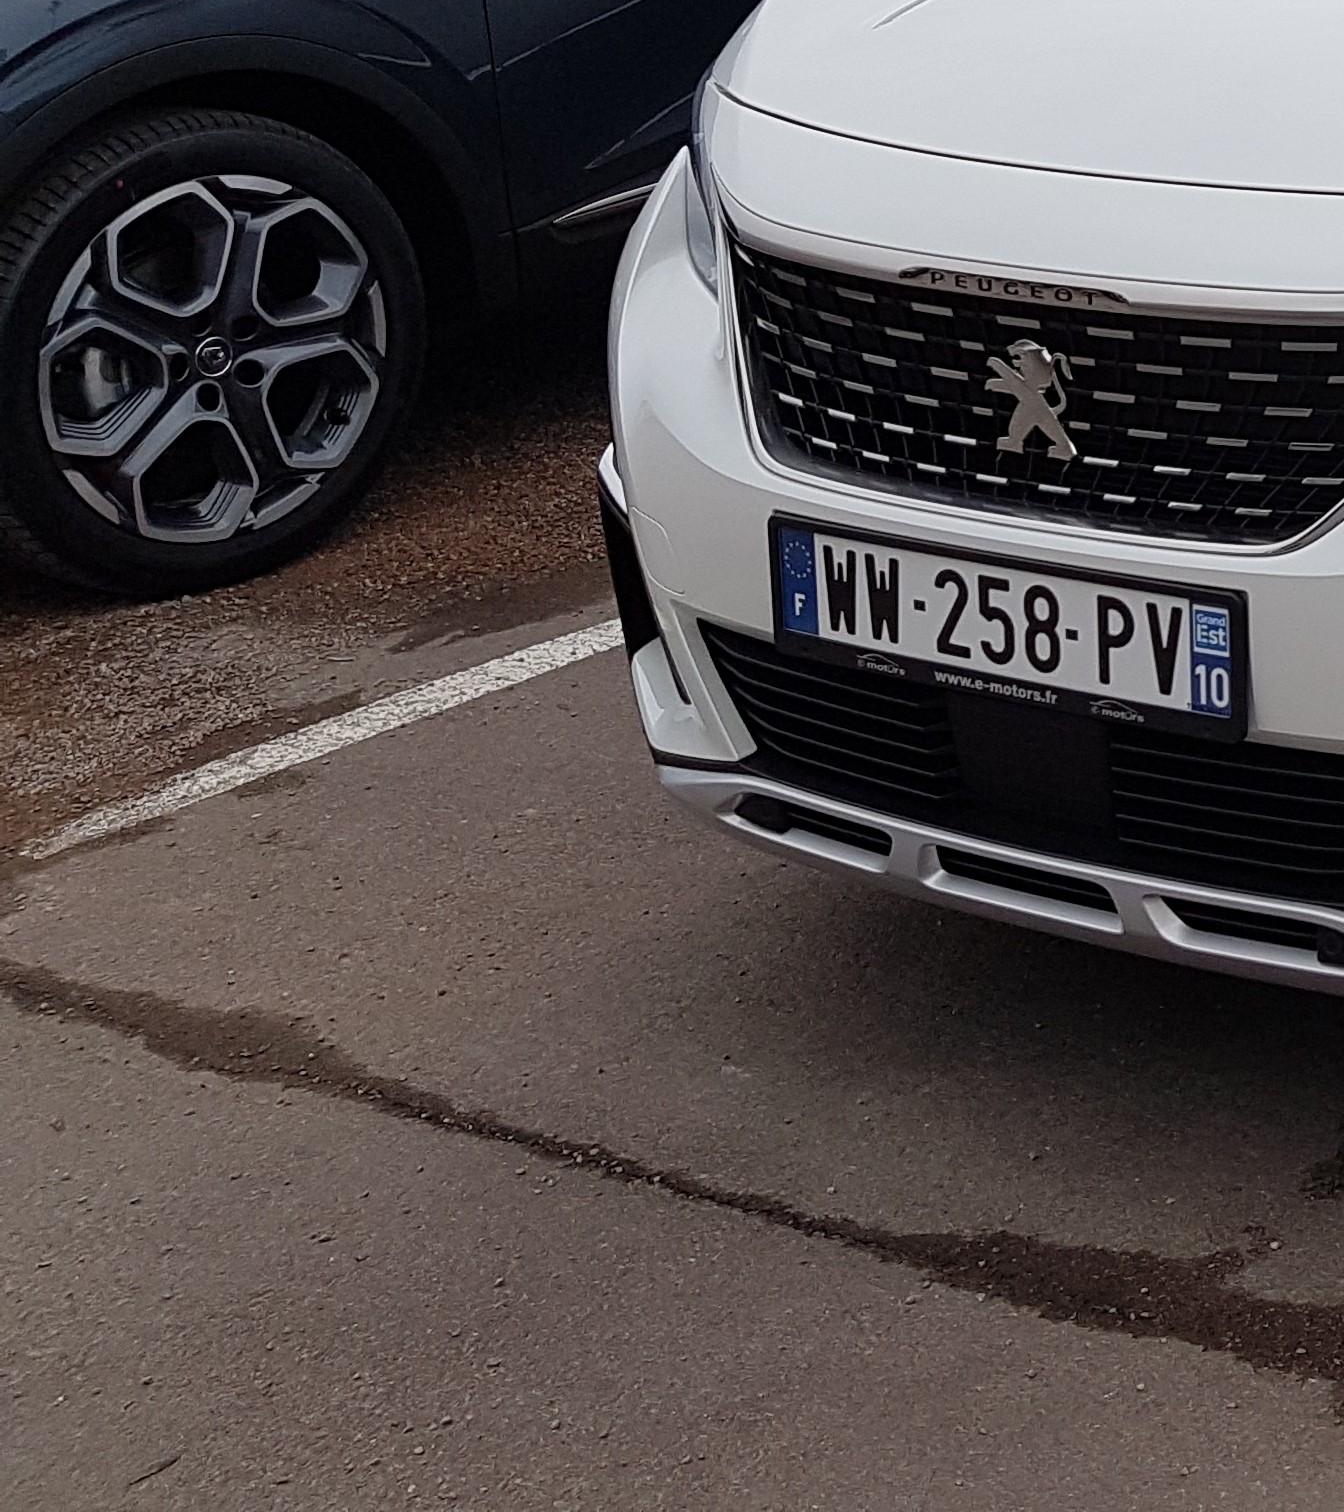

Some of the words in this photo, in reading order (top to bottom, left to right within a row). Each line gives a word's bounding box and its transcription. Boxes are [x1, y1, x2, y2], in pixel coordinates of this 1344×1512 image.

[930, 271, 1100, 306] PEUGEOT
[794, 592, 806, 616] F
[823, 544, 1183, 696] WW-258-PV
[1196, 612, 1226, 628] Grand
[1196, 625, 1227, 647] Est
[934, 670, 1058, 705] www.e-motors.fr
[1194, 663, 1230, 708] 10
